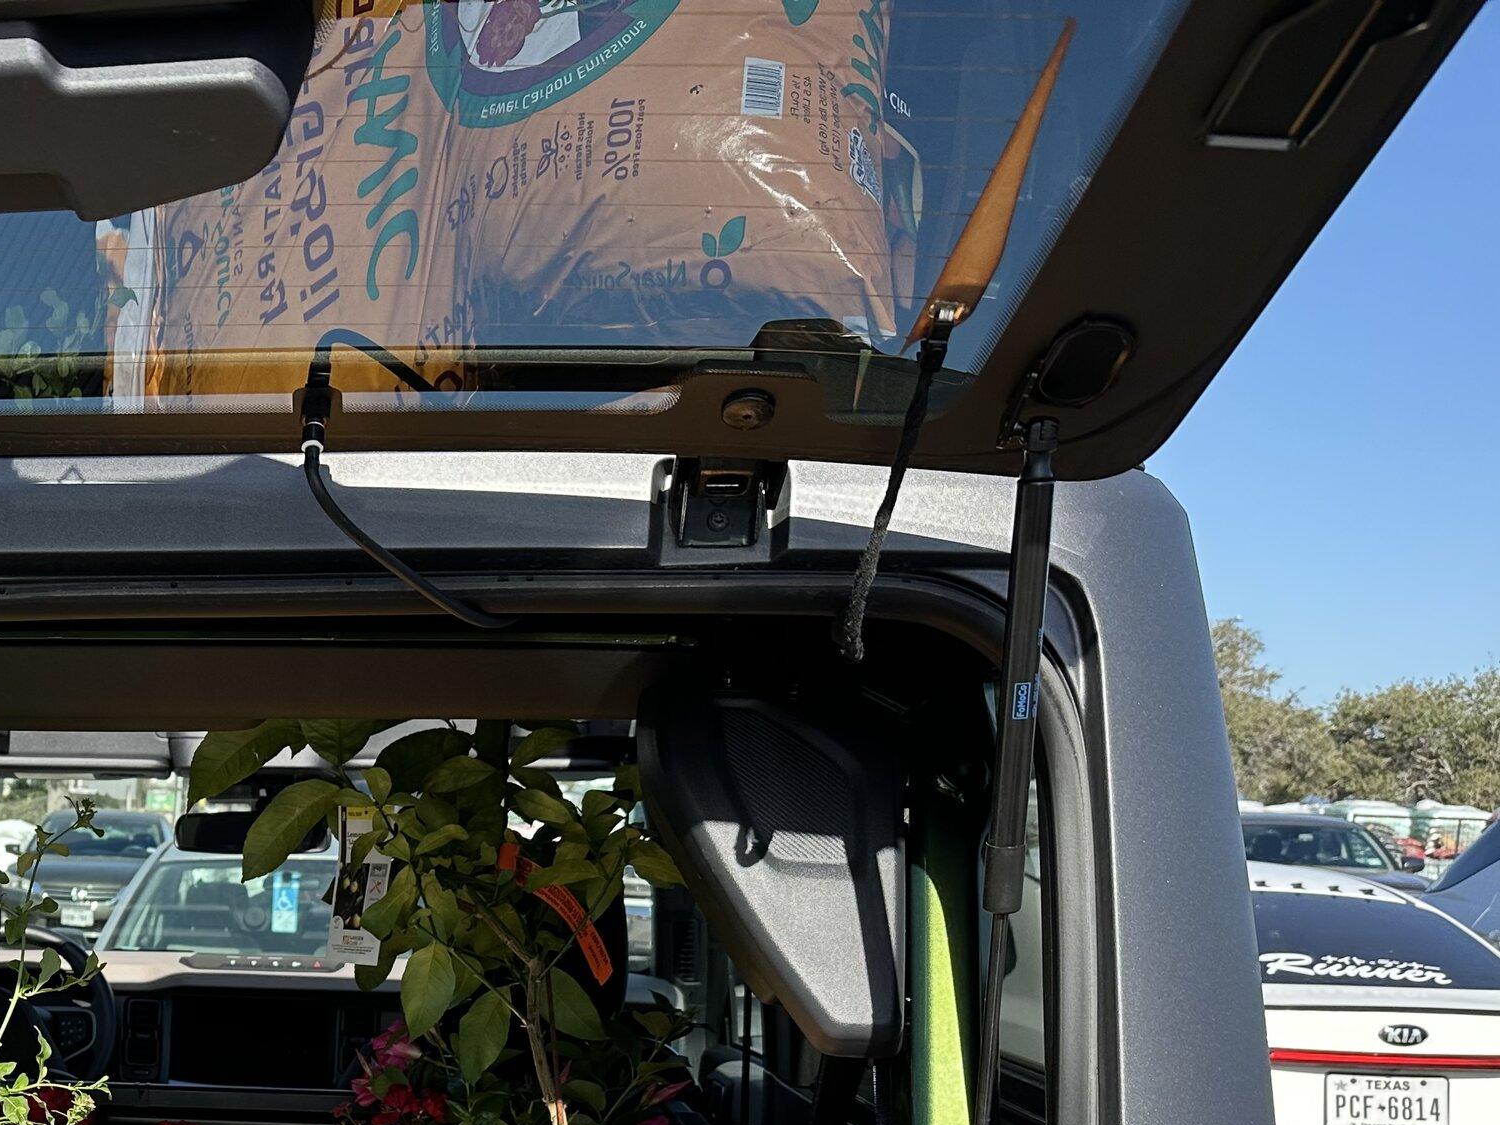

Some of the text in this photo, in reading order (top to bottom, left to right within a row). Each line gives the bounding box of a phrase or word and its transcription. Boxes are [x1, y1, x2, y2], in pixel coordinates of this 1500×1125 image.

[1258, 952, 1453, 986] Runner
[1386, 1026, 1423, 1044] KIA
[1366, 1079, 1411, 1091] TEXAS
